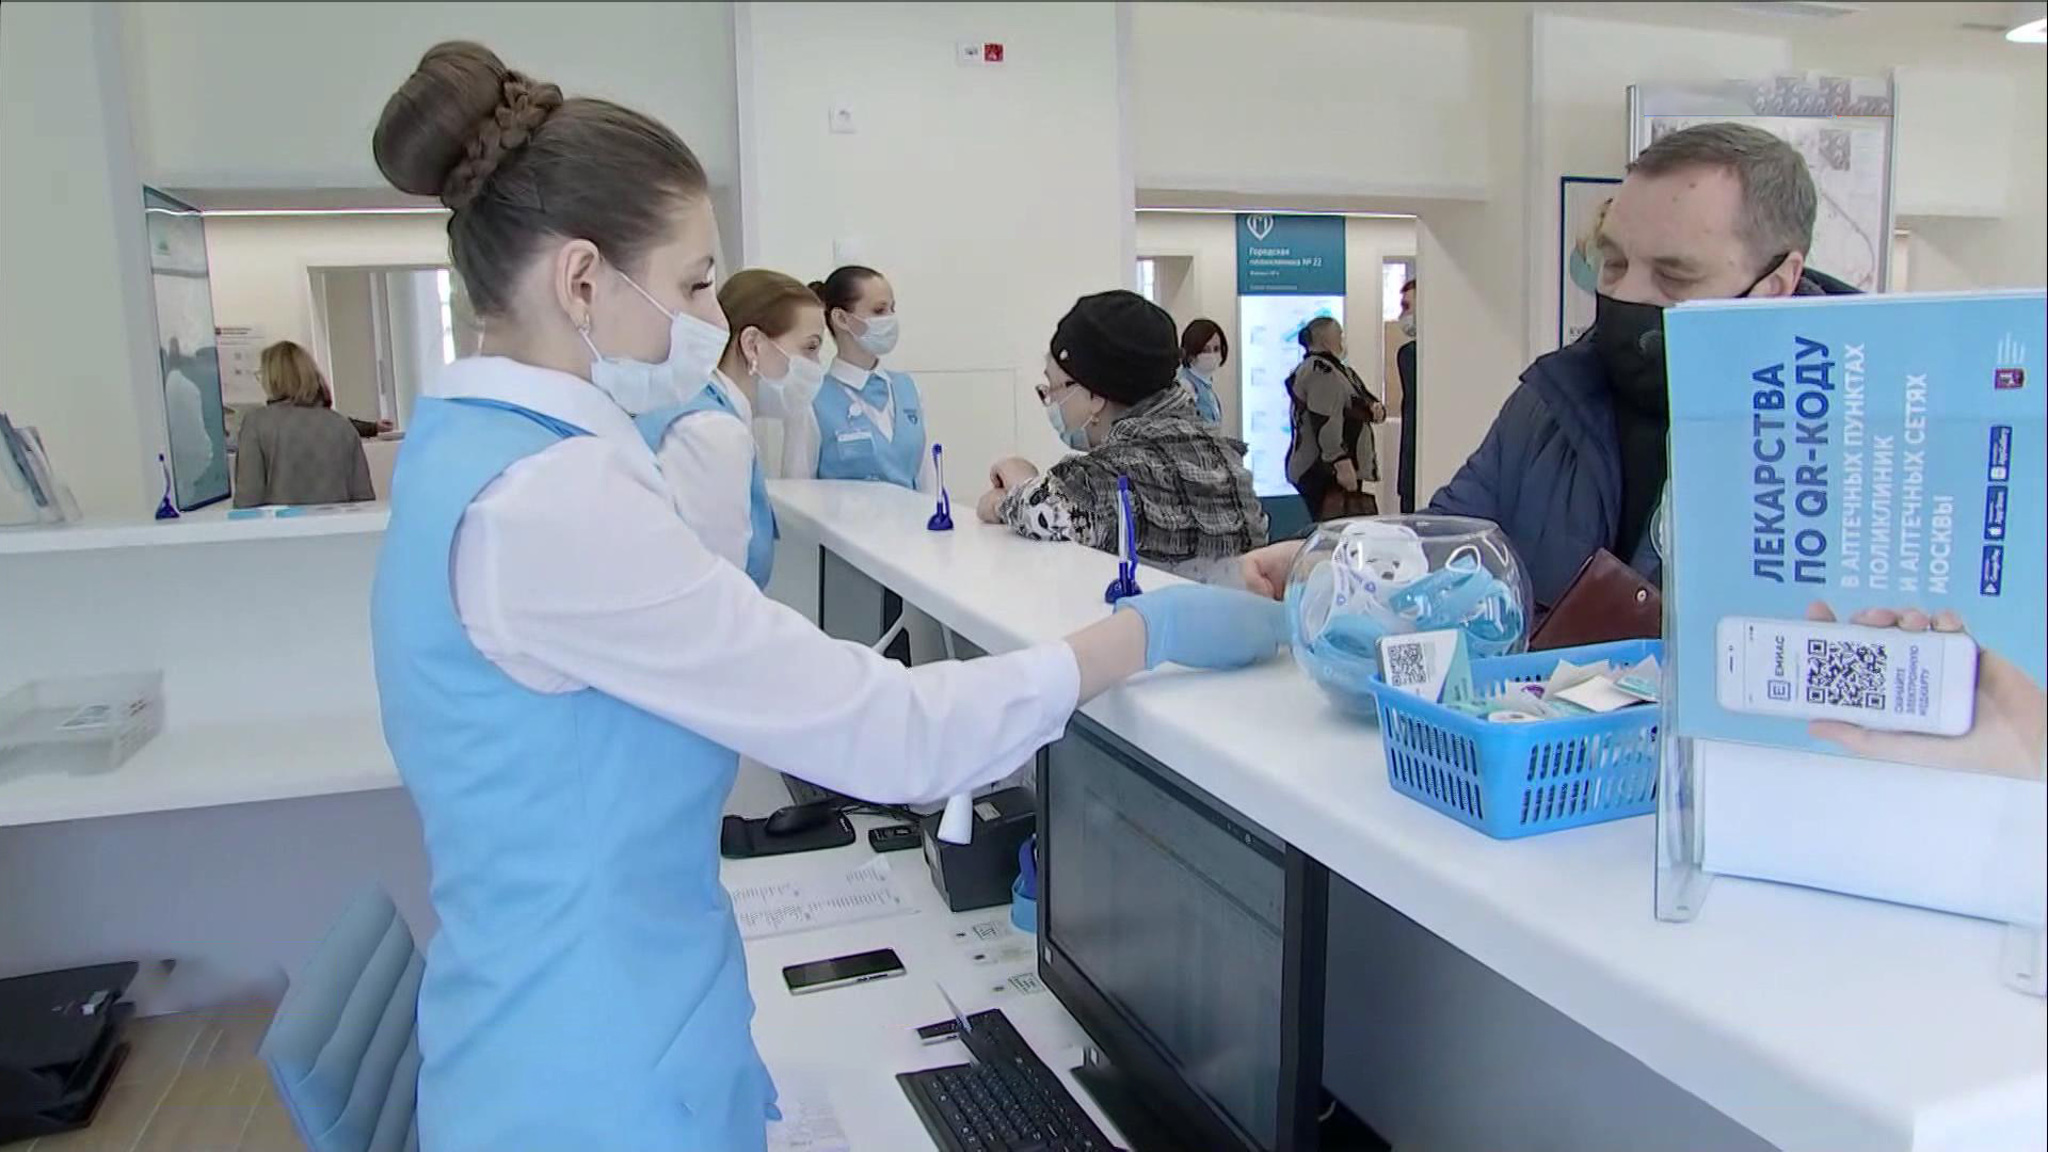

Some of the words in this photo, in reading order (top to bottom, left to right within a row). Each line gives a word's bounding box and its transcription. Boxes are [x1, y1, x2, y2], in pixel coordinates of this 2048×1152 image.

[1249, 247, 1290, 256] Городская
[1312, 257, 1322, 267] 22
[1795, 336, 1835, 517] QR-КОДУ
[1844, 342, 1865, 446] ПУНКТАХ
[1904, 373, 1927, 444] СЕТЯХ
[1752, 363, 1785, 583] ЛЕКАРСТВА
[1841, 452, 1863, 571] АПТЕЧНЫХ
[1869, 435, 1894, 589] ПОЛИКЛИНИК
[1900, 450, 1925, 568] АПТЕЧНЫХ
[1794, 529, 1827, 584] ПО
[1841, 577, 1860, 588] В
[1900, 577, 1918, 592] И
[1928, 495, 1954, 594] МОСКВЫ
[1774, 635, 1785, 676] ЕМИАС
